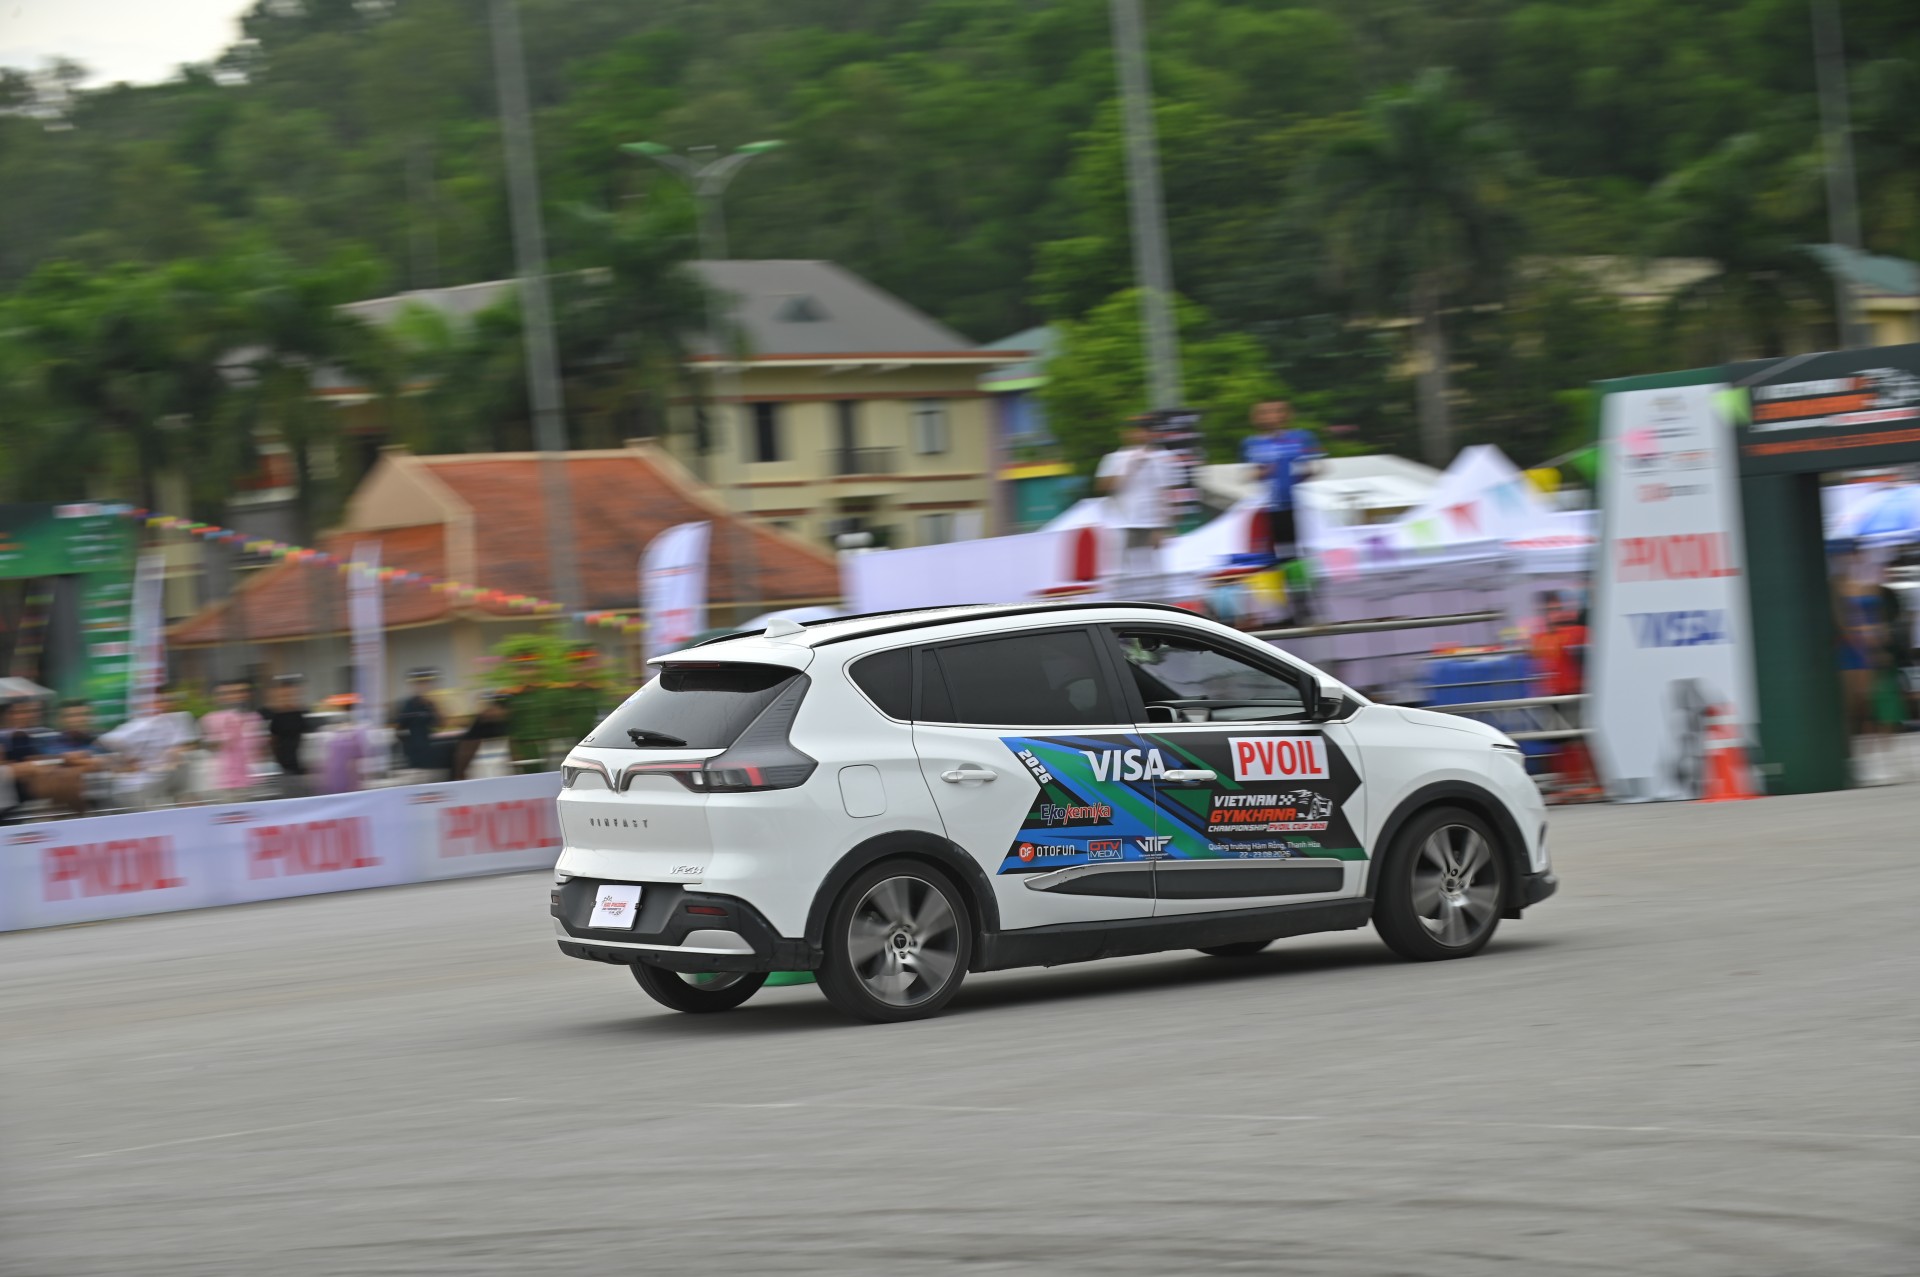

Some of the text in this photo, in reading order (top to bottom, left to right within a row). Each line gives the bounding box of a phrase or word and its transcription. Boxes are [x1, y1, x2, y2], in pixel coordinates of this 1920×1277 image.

[1237, 740, 1322, 776] PVOIL
[1018, 749, 1053, 784] 2026
[1079, 748, 1166, 782] VISA
[1214, 794, 1278, 807] VIETNAM
[1041, 802, 1111, 826] Ekokemika
[1210, 808, 1297, 823] GYMKHANA
[590, 818, 648, 828] VINFAST
[1208, 824, 1267, 832] CHAMPIONSHIP
[1036, 844, 1075, 857] OTOFUN
[1089, 841, 1120, 850] OTV
[1090, 850, 1121, 858] MEDIA
